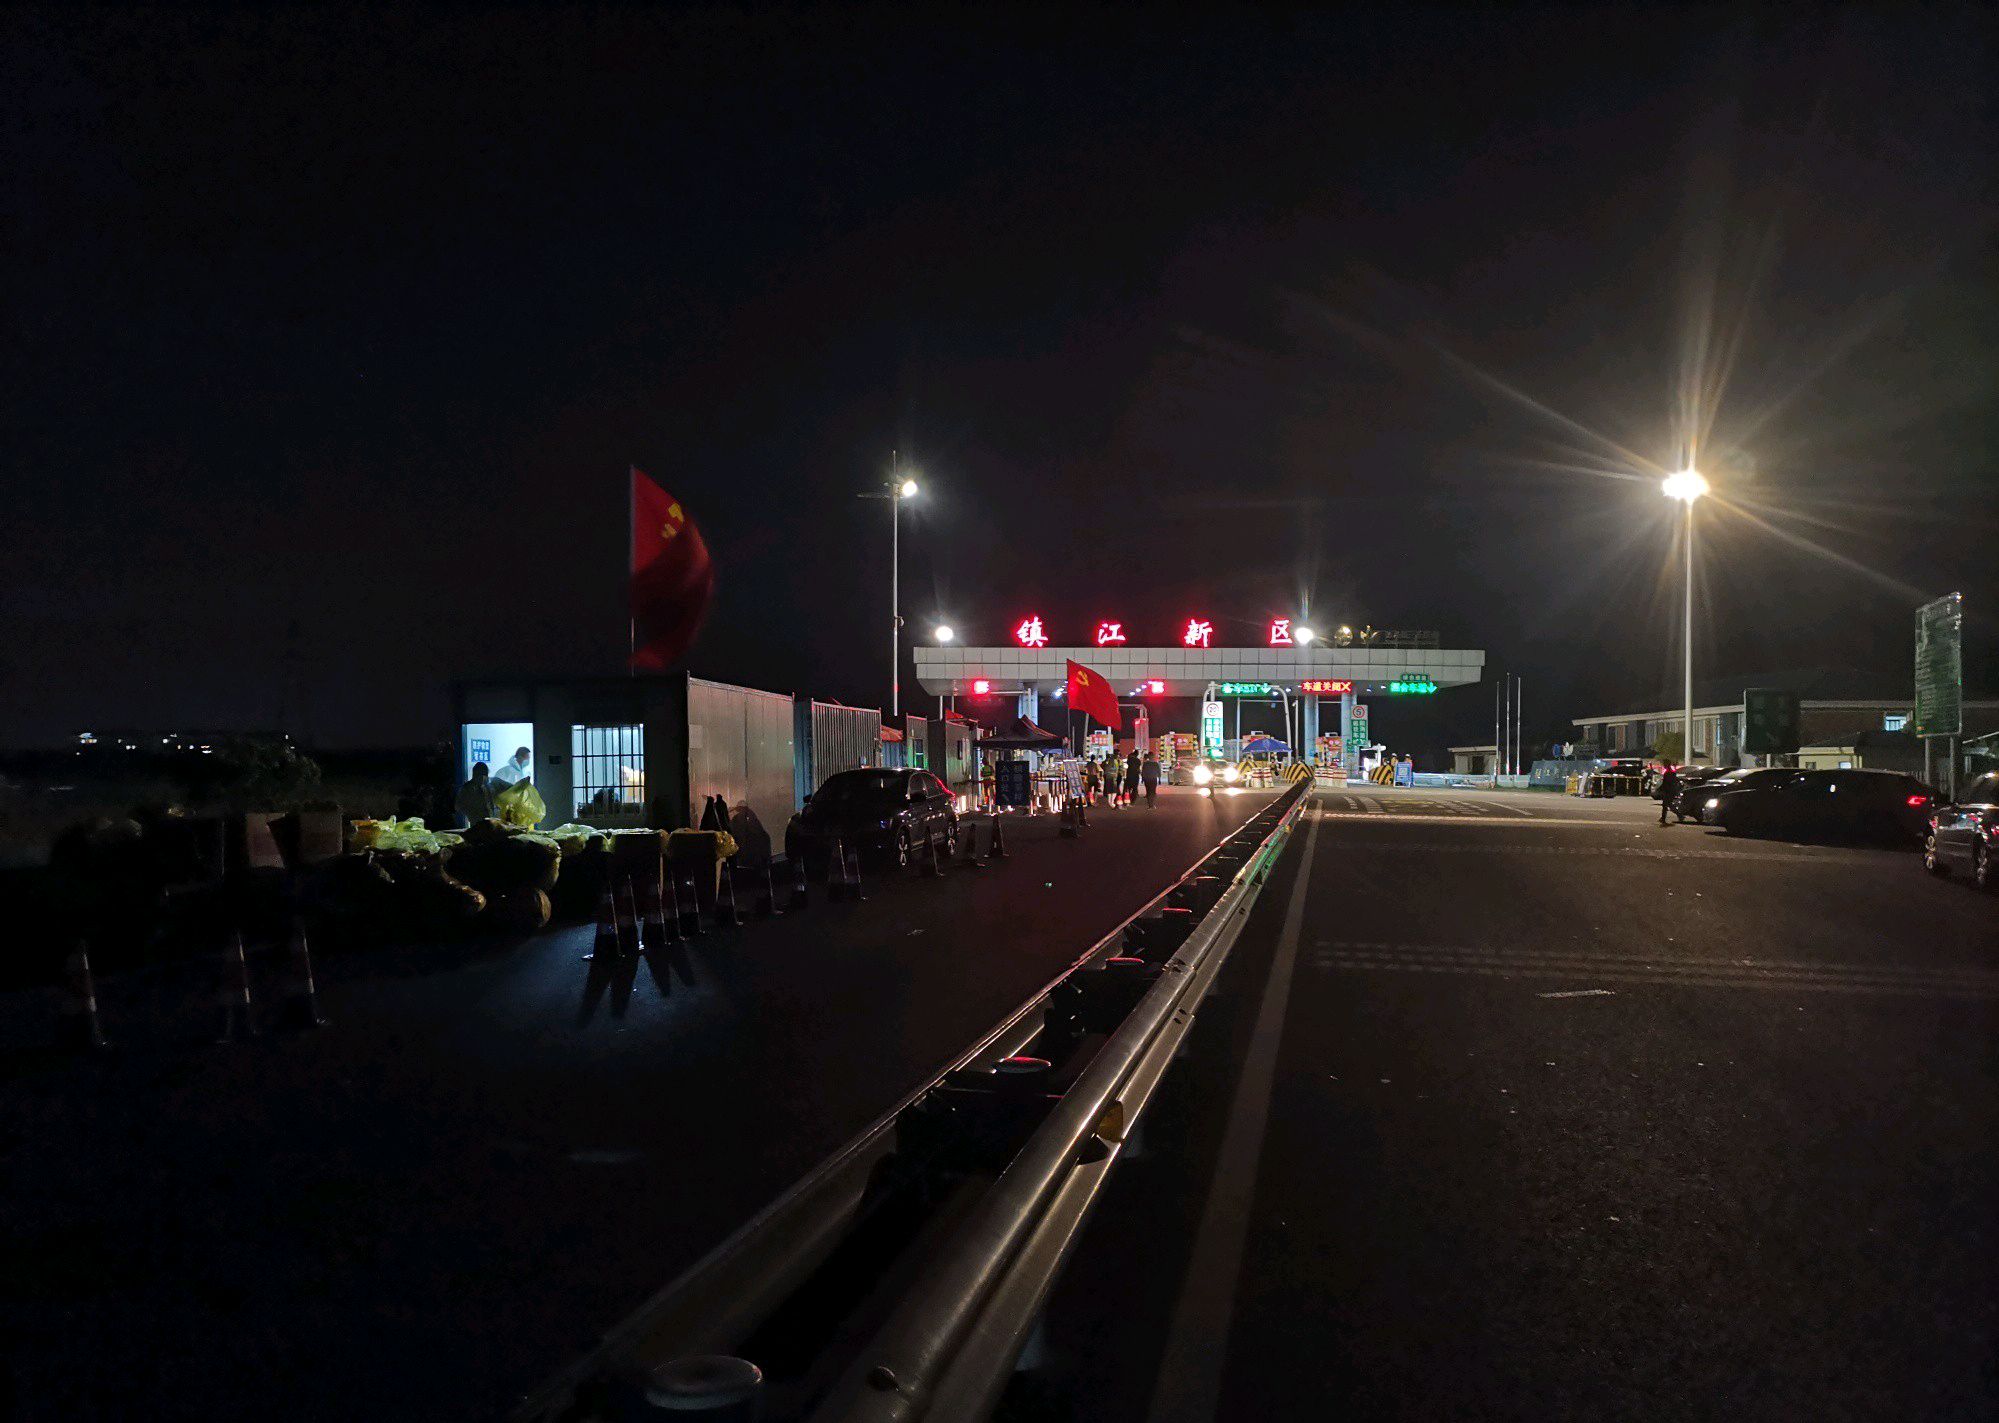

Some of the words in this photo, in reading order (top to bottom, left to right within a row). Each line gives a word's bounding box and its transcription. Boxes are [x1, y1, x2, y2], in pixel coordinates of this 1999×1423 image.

[1017, 617, 1293, 647] 镇江新区
[1303, 681, 1342, 692] 车道关闭
